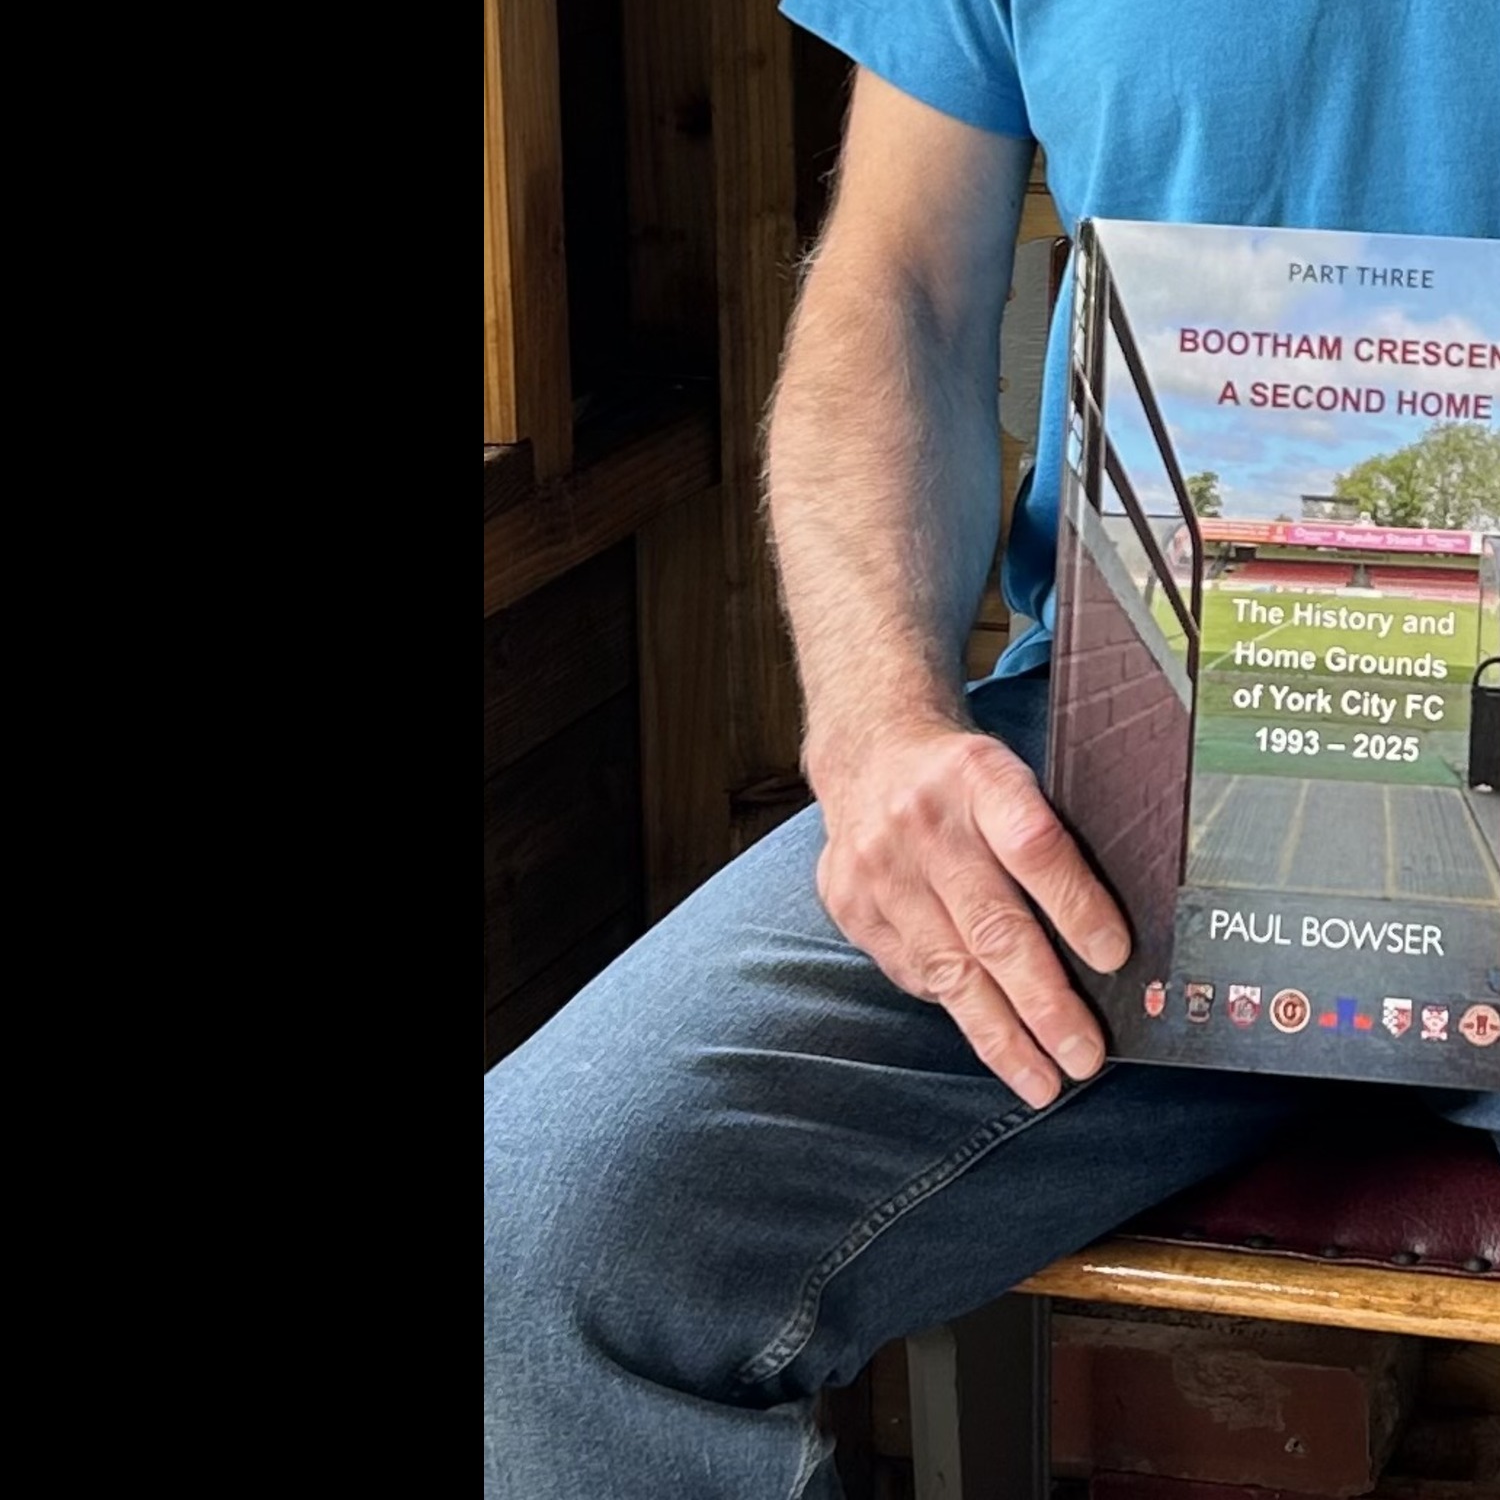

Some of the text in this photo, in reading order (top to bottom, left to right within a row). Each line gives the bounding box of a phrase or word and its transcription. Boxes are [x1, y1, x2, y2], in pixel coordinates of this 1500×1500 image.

[1289, 263, 1435, 289] PART THREE
[1179, 328, 1342, 361] BOOTHAM
[1218, 381, 1493, 419] A SECOND HOME
[1233, 599, 1455, 639] The History and
[1233, 642, 1449, 679] Home Grounds
[1233, 684, 1445, 724] of York City FC
[1255, 727, 1320, 756] 1993
[1352, 733, 1420, 763] 2025
[1210, 909, 1445, 956] PAUL BOWSER
